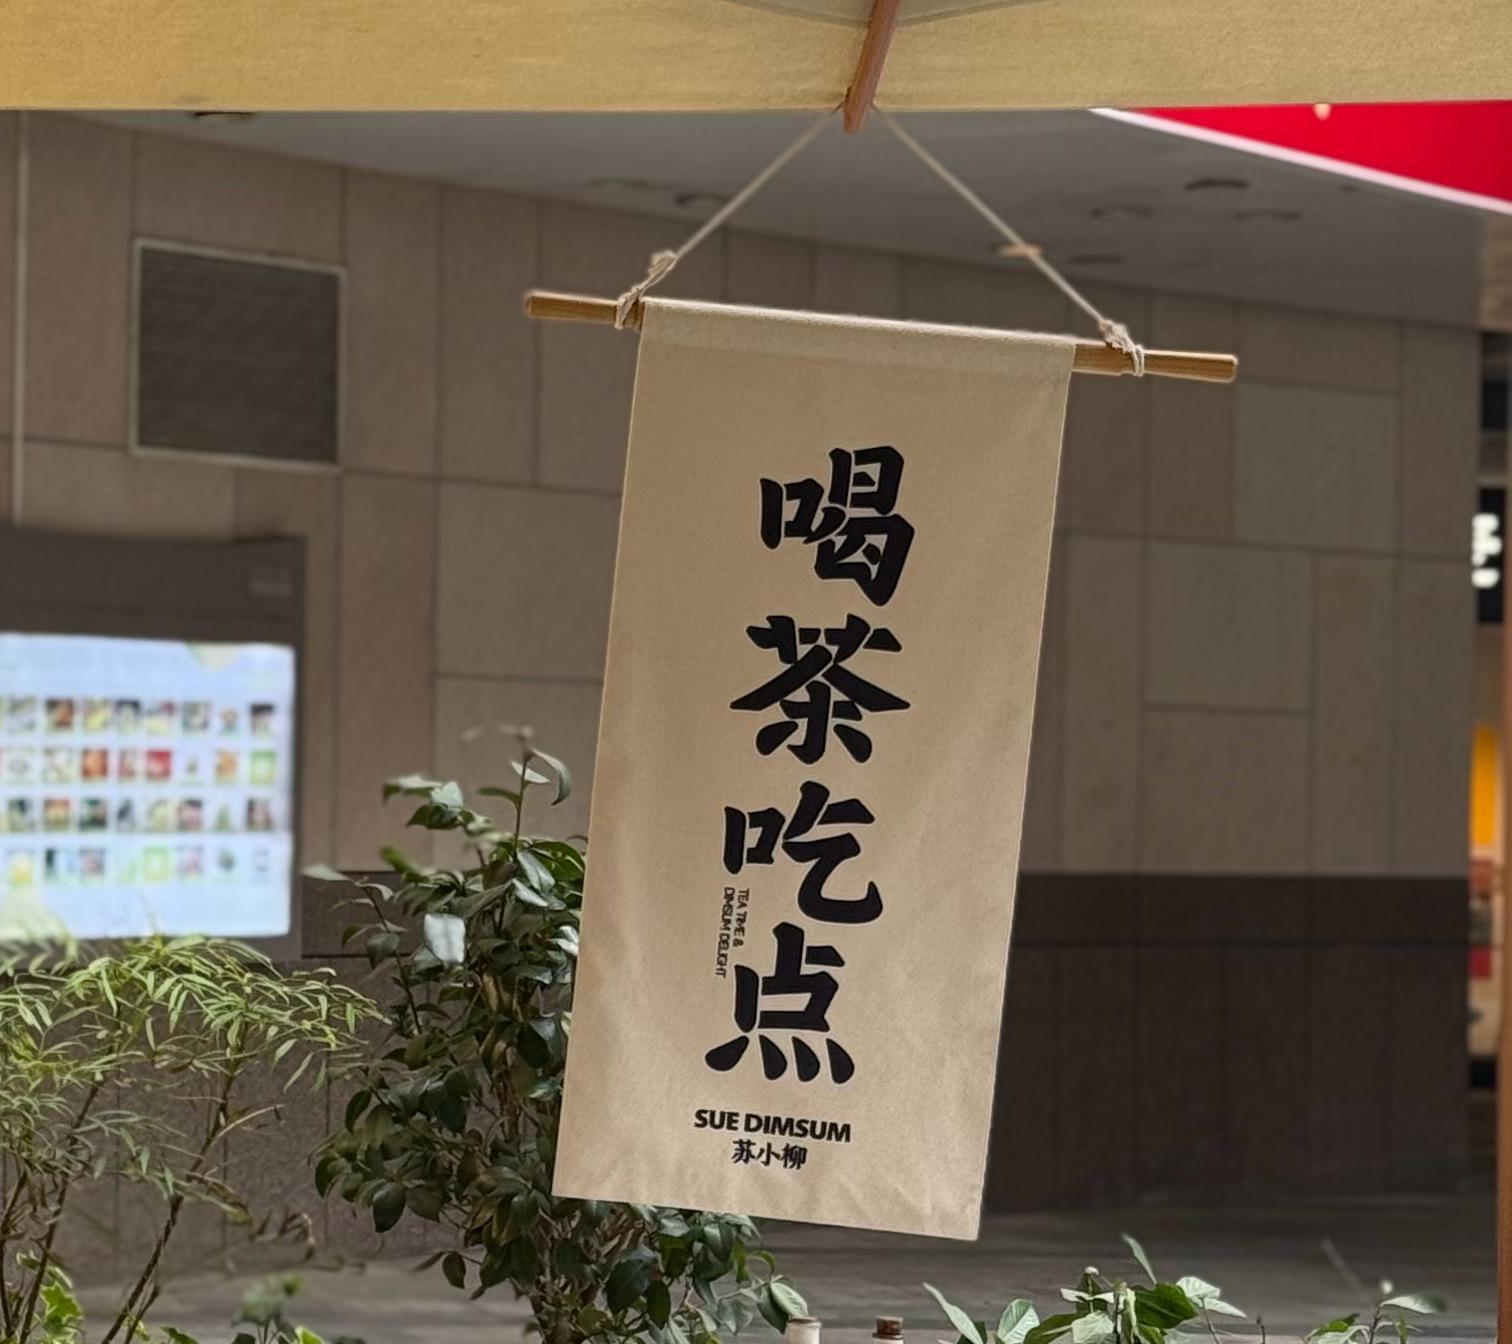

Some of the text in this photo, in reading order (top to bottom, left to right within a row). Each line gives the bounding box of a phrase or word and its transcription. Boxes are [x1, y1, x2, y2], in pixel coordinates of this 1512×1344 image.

[704, 444, 916, 1085] 喝茶吃点
[693, 1109, 851, 1143] SUE DIMSUM
[731, 1138, 808, 1170] 苏小柳
